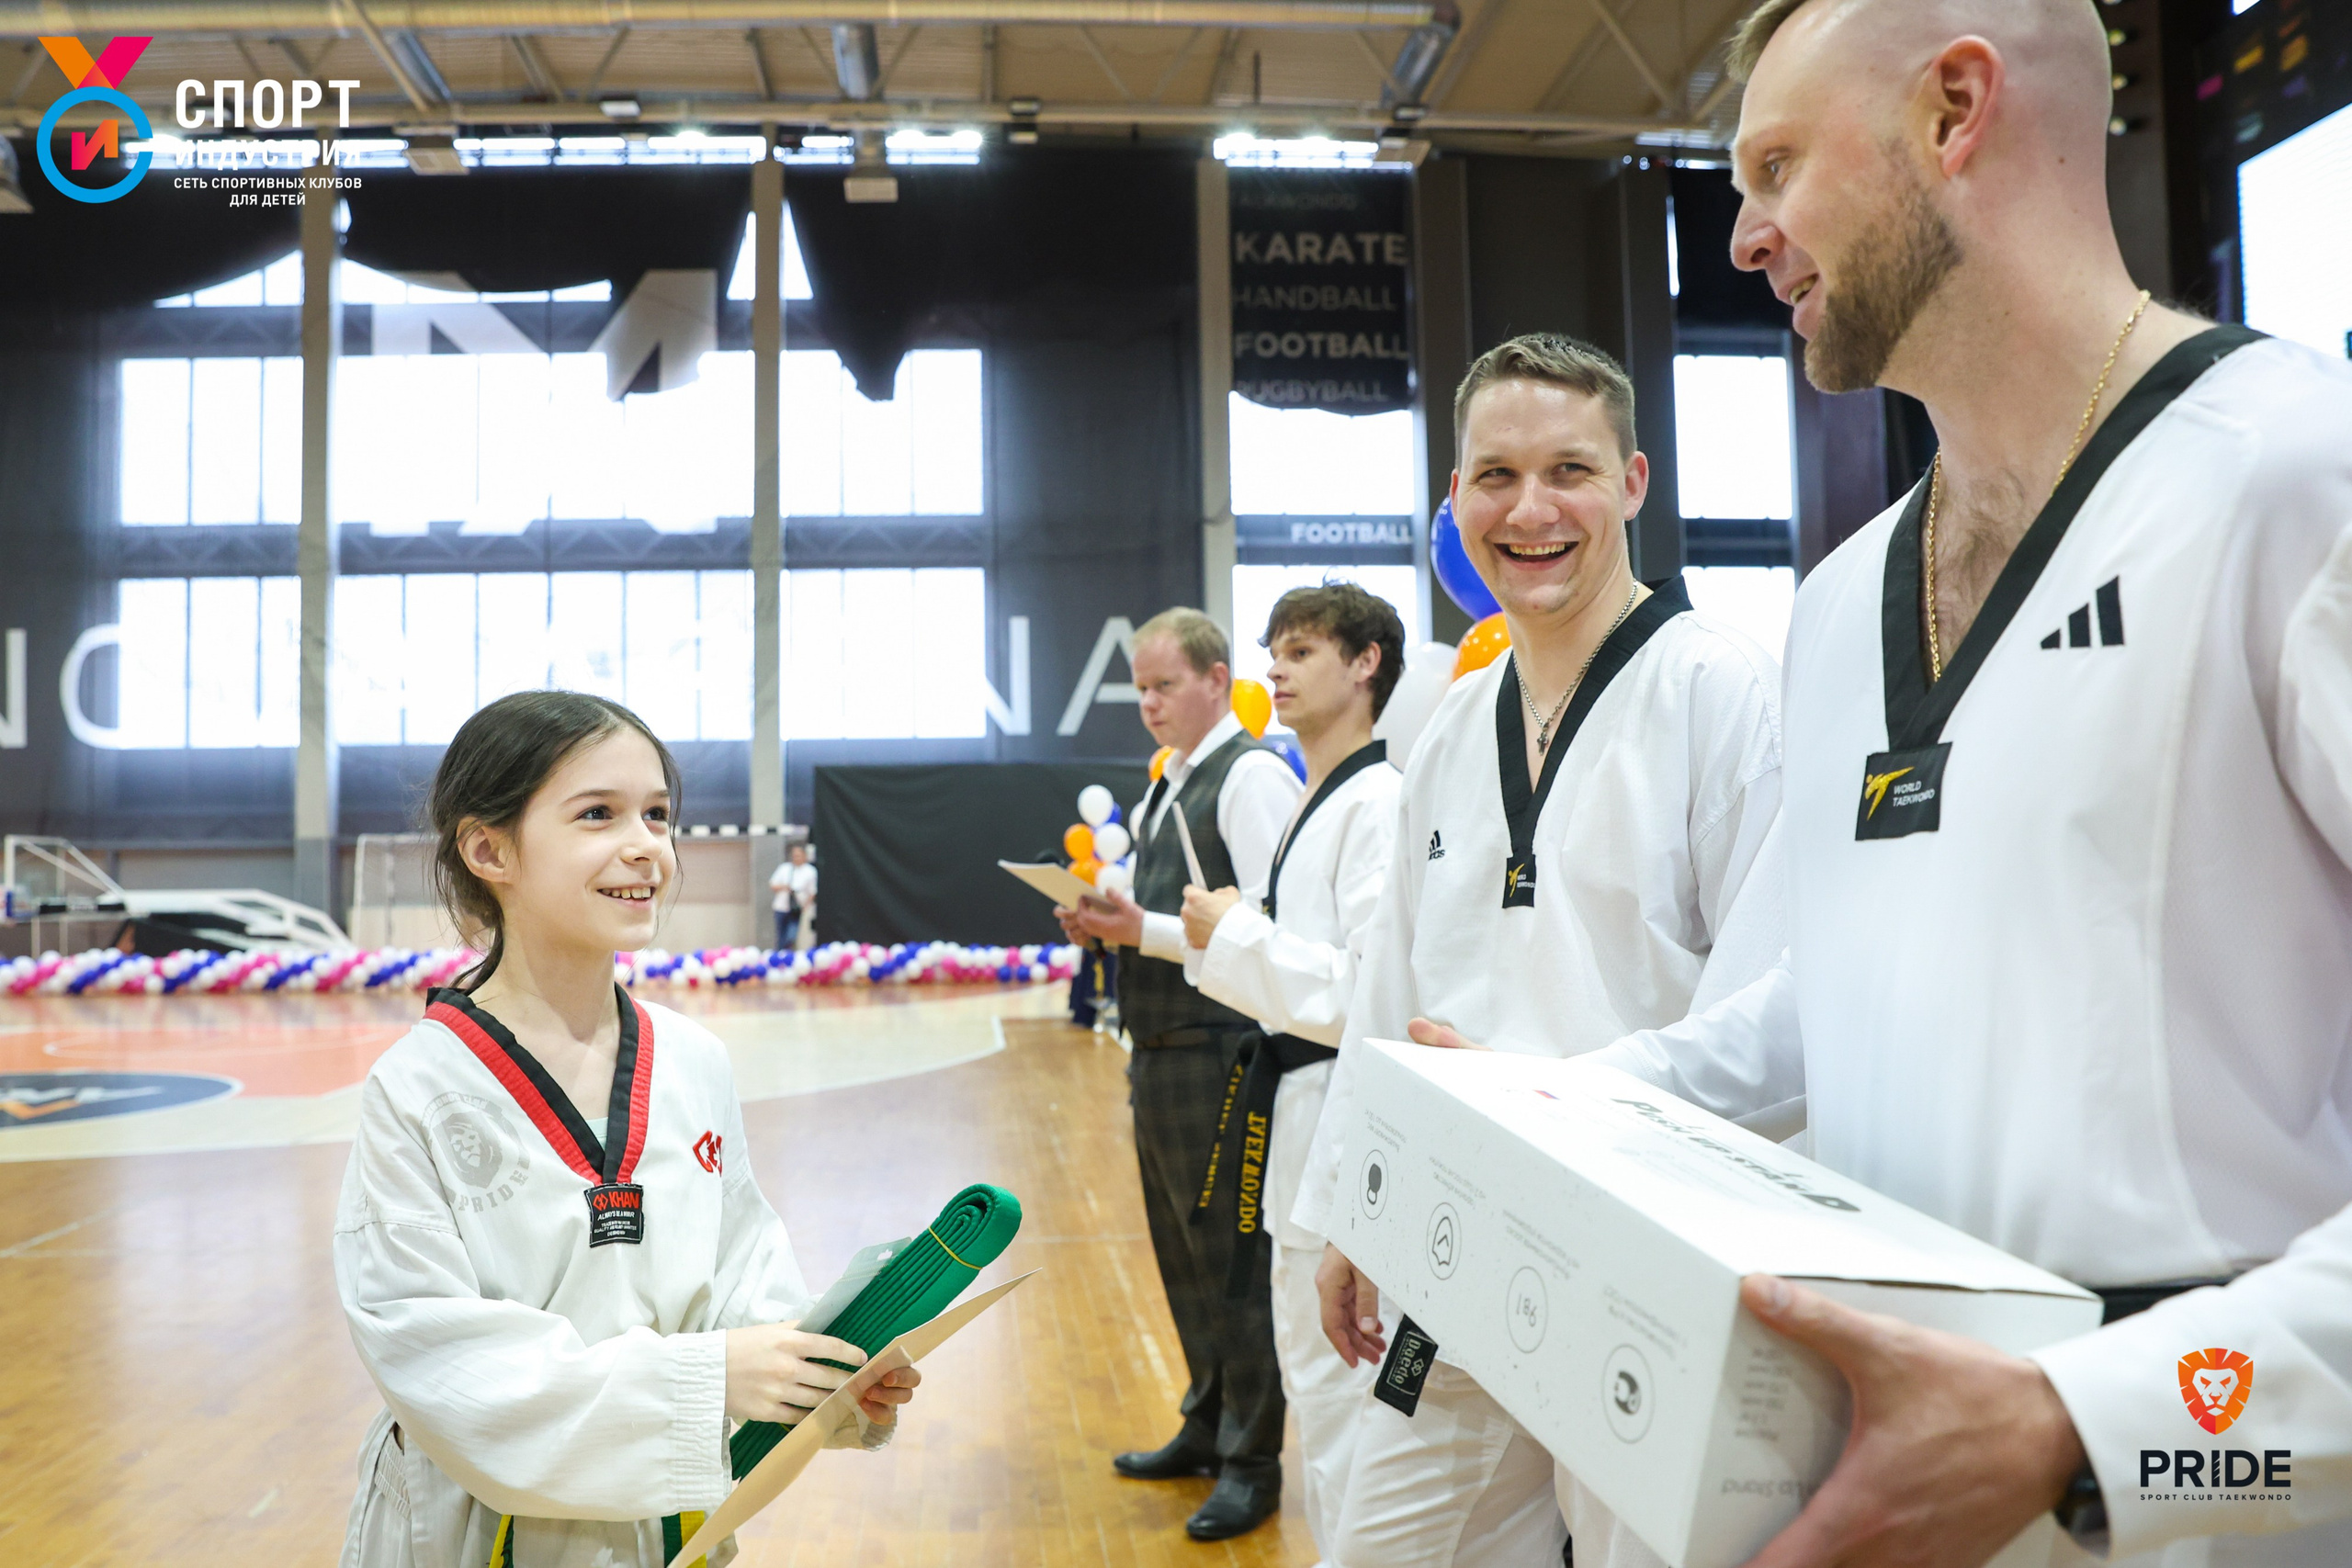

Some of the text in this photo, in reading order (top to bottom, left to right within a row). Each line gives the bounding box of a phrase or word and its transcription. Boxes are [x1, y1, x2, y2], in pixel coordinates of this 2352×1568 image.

[1235, 232, 1410, 265] KARATE
[1233, 284, 1397, 311] HANDBALL
[1235, 332, 1413, 359] FOOTBALL
[1291, 522, 1415, 547] FOOTBALL
[1893, 780, 1922, 795] WORLD
[1238, 1111, 1267, 1234] TAEKWONDO
[608, 1190, 640, 1209] KHAN
[1394, 1338, 1421, 1384] Daedo
